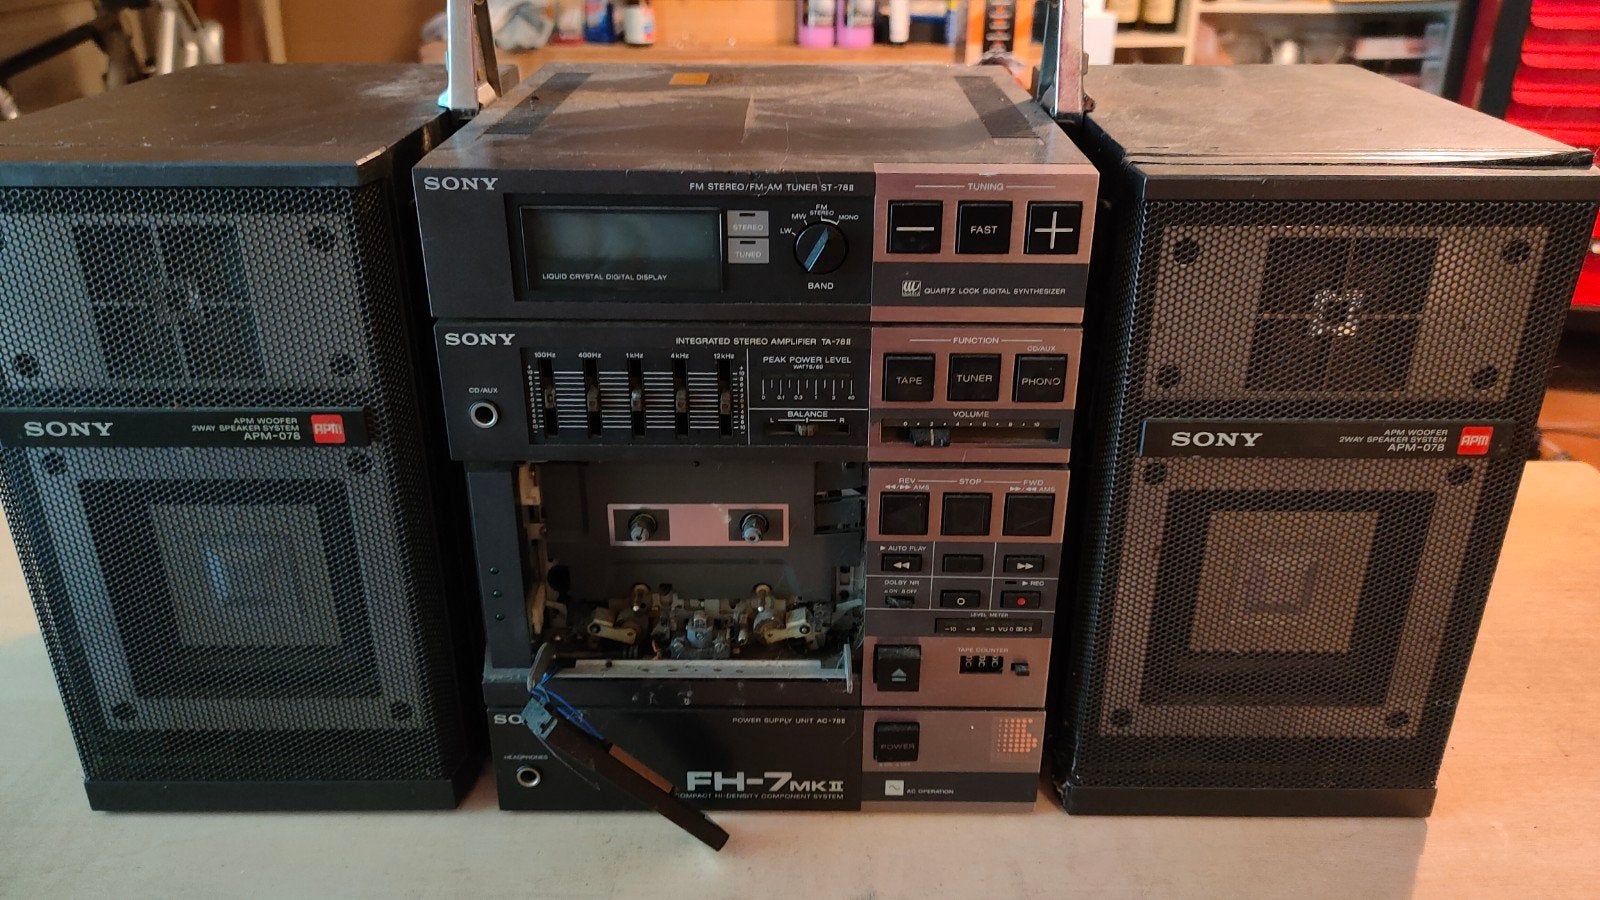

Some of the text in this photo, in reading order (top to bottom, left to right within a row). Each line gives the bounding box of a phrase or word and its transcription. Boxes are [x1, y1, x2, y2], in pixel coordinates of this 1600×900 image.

[424, 177, 498, 191] SONY
[690, 183, 704, 192] FM
[708, 183, 783, 192] STEREO/FM-AM
[787, 183, 817, 192] TUNER
[967, 182, 1004, 191] TUNING
[732, 223, 764, 231] STEREO
[970, 225, 998, 235] FAST
[734, 250, 762, 258] TUNED
[542, 273, 668, 281] LIQUID CRYSTAL DIGITAL DISPLAY
[807, 282, 834, 290] BAND
[924, 287, 955, 295] QUARTZ
[959, 287, 979, 295] LOCK
[983, 287, 1010, 295] DIGITAL
[1013, 287, 1066, 295] SYNTHESIZER
[445, 333, 515, 347] SONY
[675, 337, 730, 345] INTEGRATED
[733, 337, 768, 345] STEREO
[770, 337, 817, 346] AMPLIFIER
[953, 336, 999, 345] FUNCTION
[763, 356, 852, 364] PEAK POWER LEVEL
[896, 376, 922, 385] TAPE
[956, 374, 992, 383] TUNER
[1021, 377, 1061, 386] PHONO
[787, 410, 828, 418] BALANCE
[24, 422, 113, 436] SONY
[191, 424, 300, 432] 2WAY SPEAKER SYSTEM
[314, 422, 342, 435] APM
[243, 432, 301, 441] APM-078
[1171, 432, 1263, 447] SONY
[1460, 434, 1489, 446] APM
[1387, 443, 1444, 452] APM-078
[494, 714, 526, 725] SO
[687, 771, 793, 792] FH-7
[761, 792, 811, 800] COMPONENT
[813, 792, 844, 800] SYSTEM
